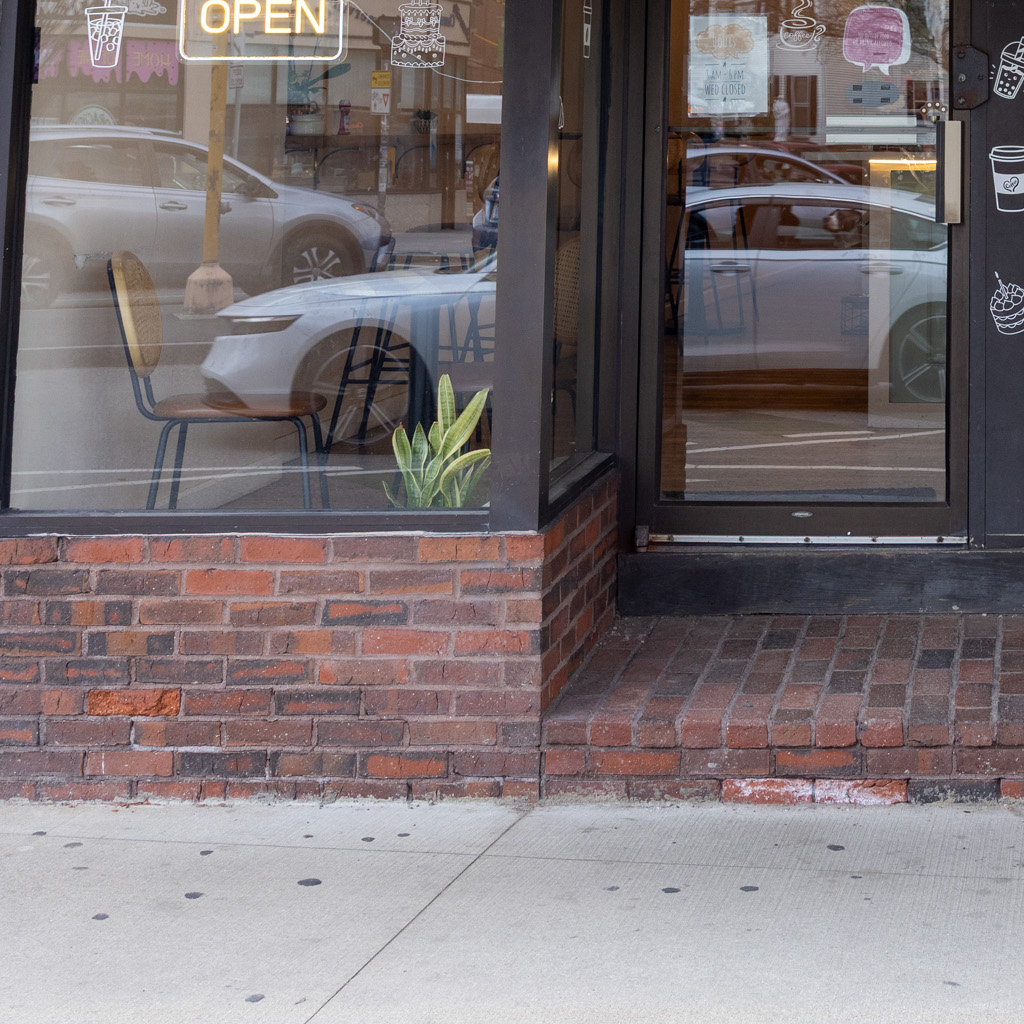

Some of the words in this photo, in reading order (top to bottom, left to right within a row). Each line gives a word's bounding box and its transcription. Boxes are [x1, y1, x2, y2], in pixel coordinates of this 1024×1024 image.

[783, 30, 812, 42] coffee
[704, 83, 719, 95] WED
[721, 83, 746, 95] CLOSED
